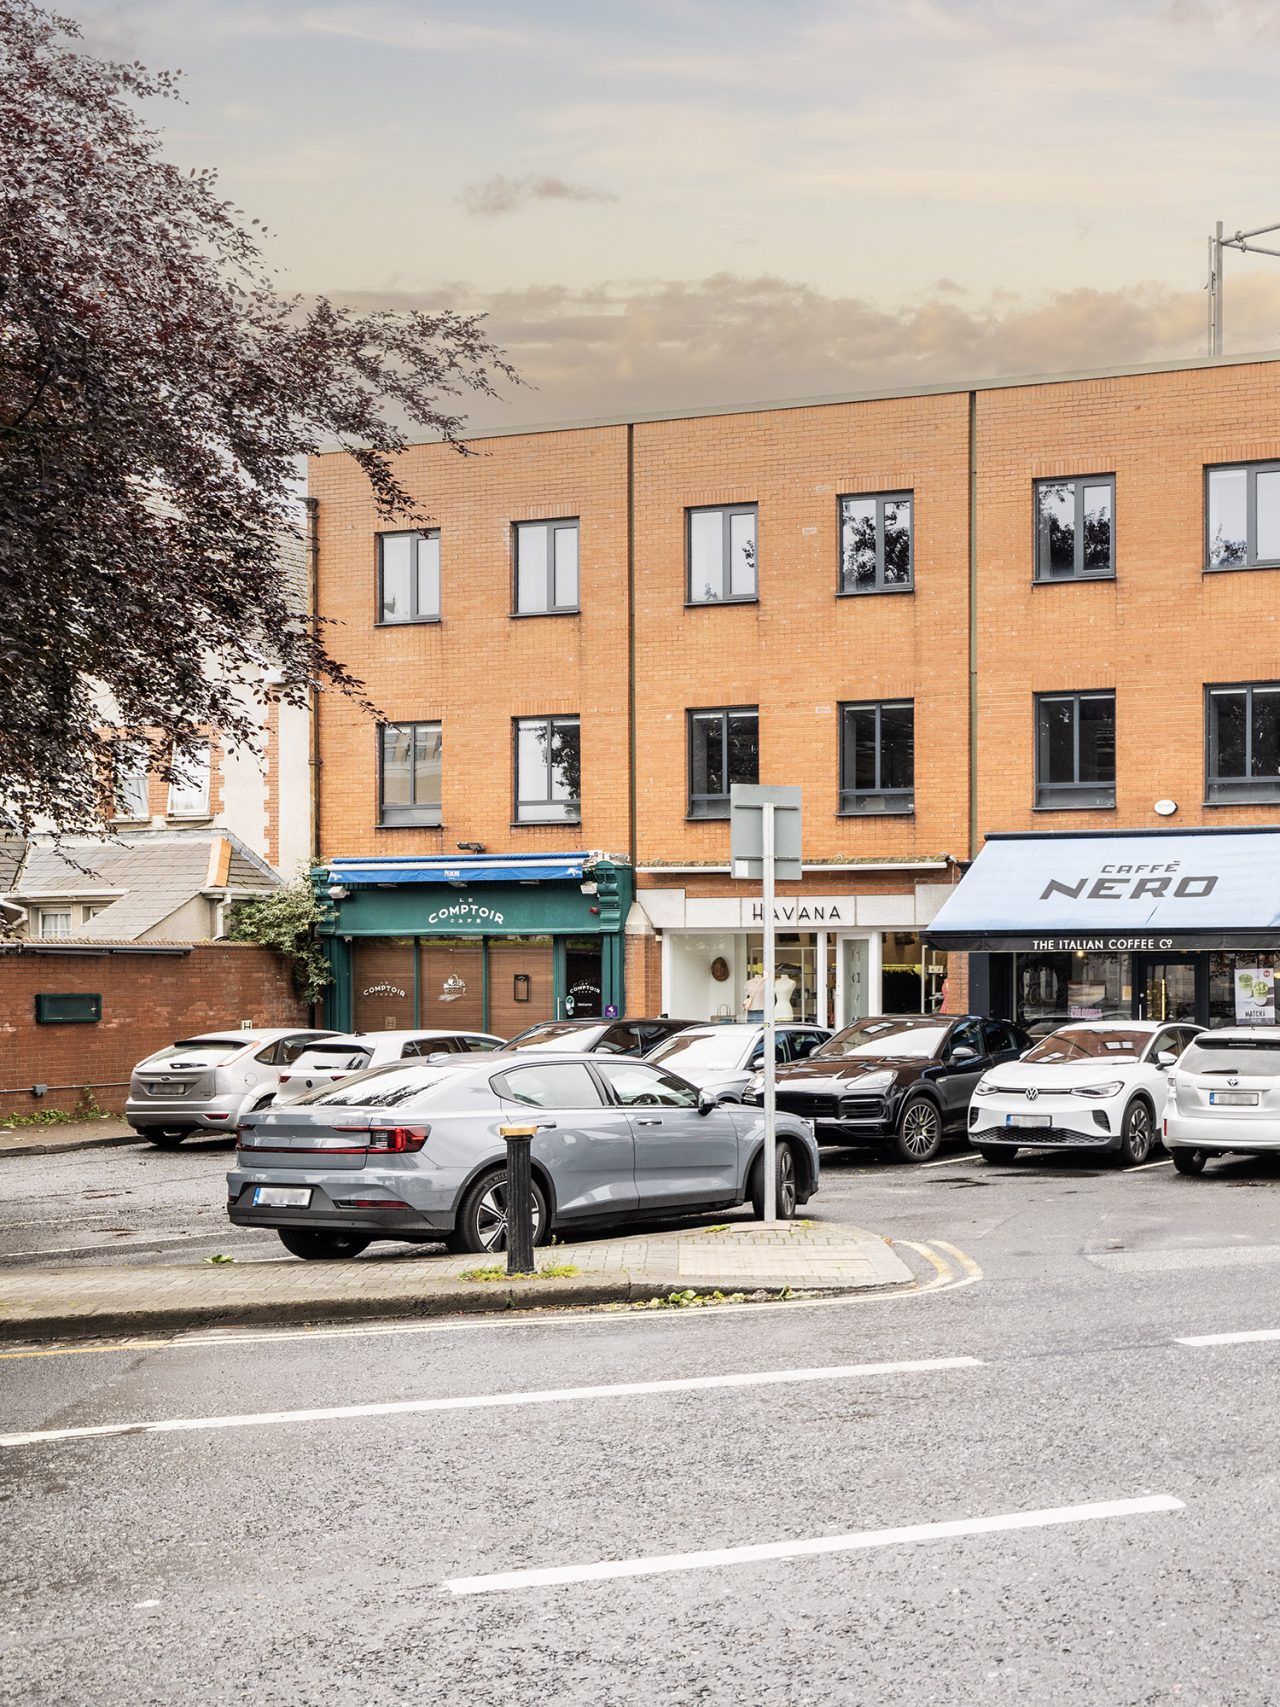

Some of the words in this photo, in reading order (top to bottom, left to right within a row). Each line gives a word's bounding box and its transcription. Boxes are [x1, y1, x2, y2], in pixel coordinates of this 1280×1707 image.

[1040, 876, 1219, 900] NERO
[428, 904, 504, 925] COMPTOIR
[1032, 940, 1054, 950] THE
[1059, 939, 1104, 950] ITALIAN
[1108, 939, 1154, 950] COFFEE
[363, 985, 406, 997] COMPTOIR
